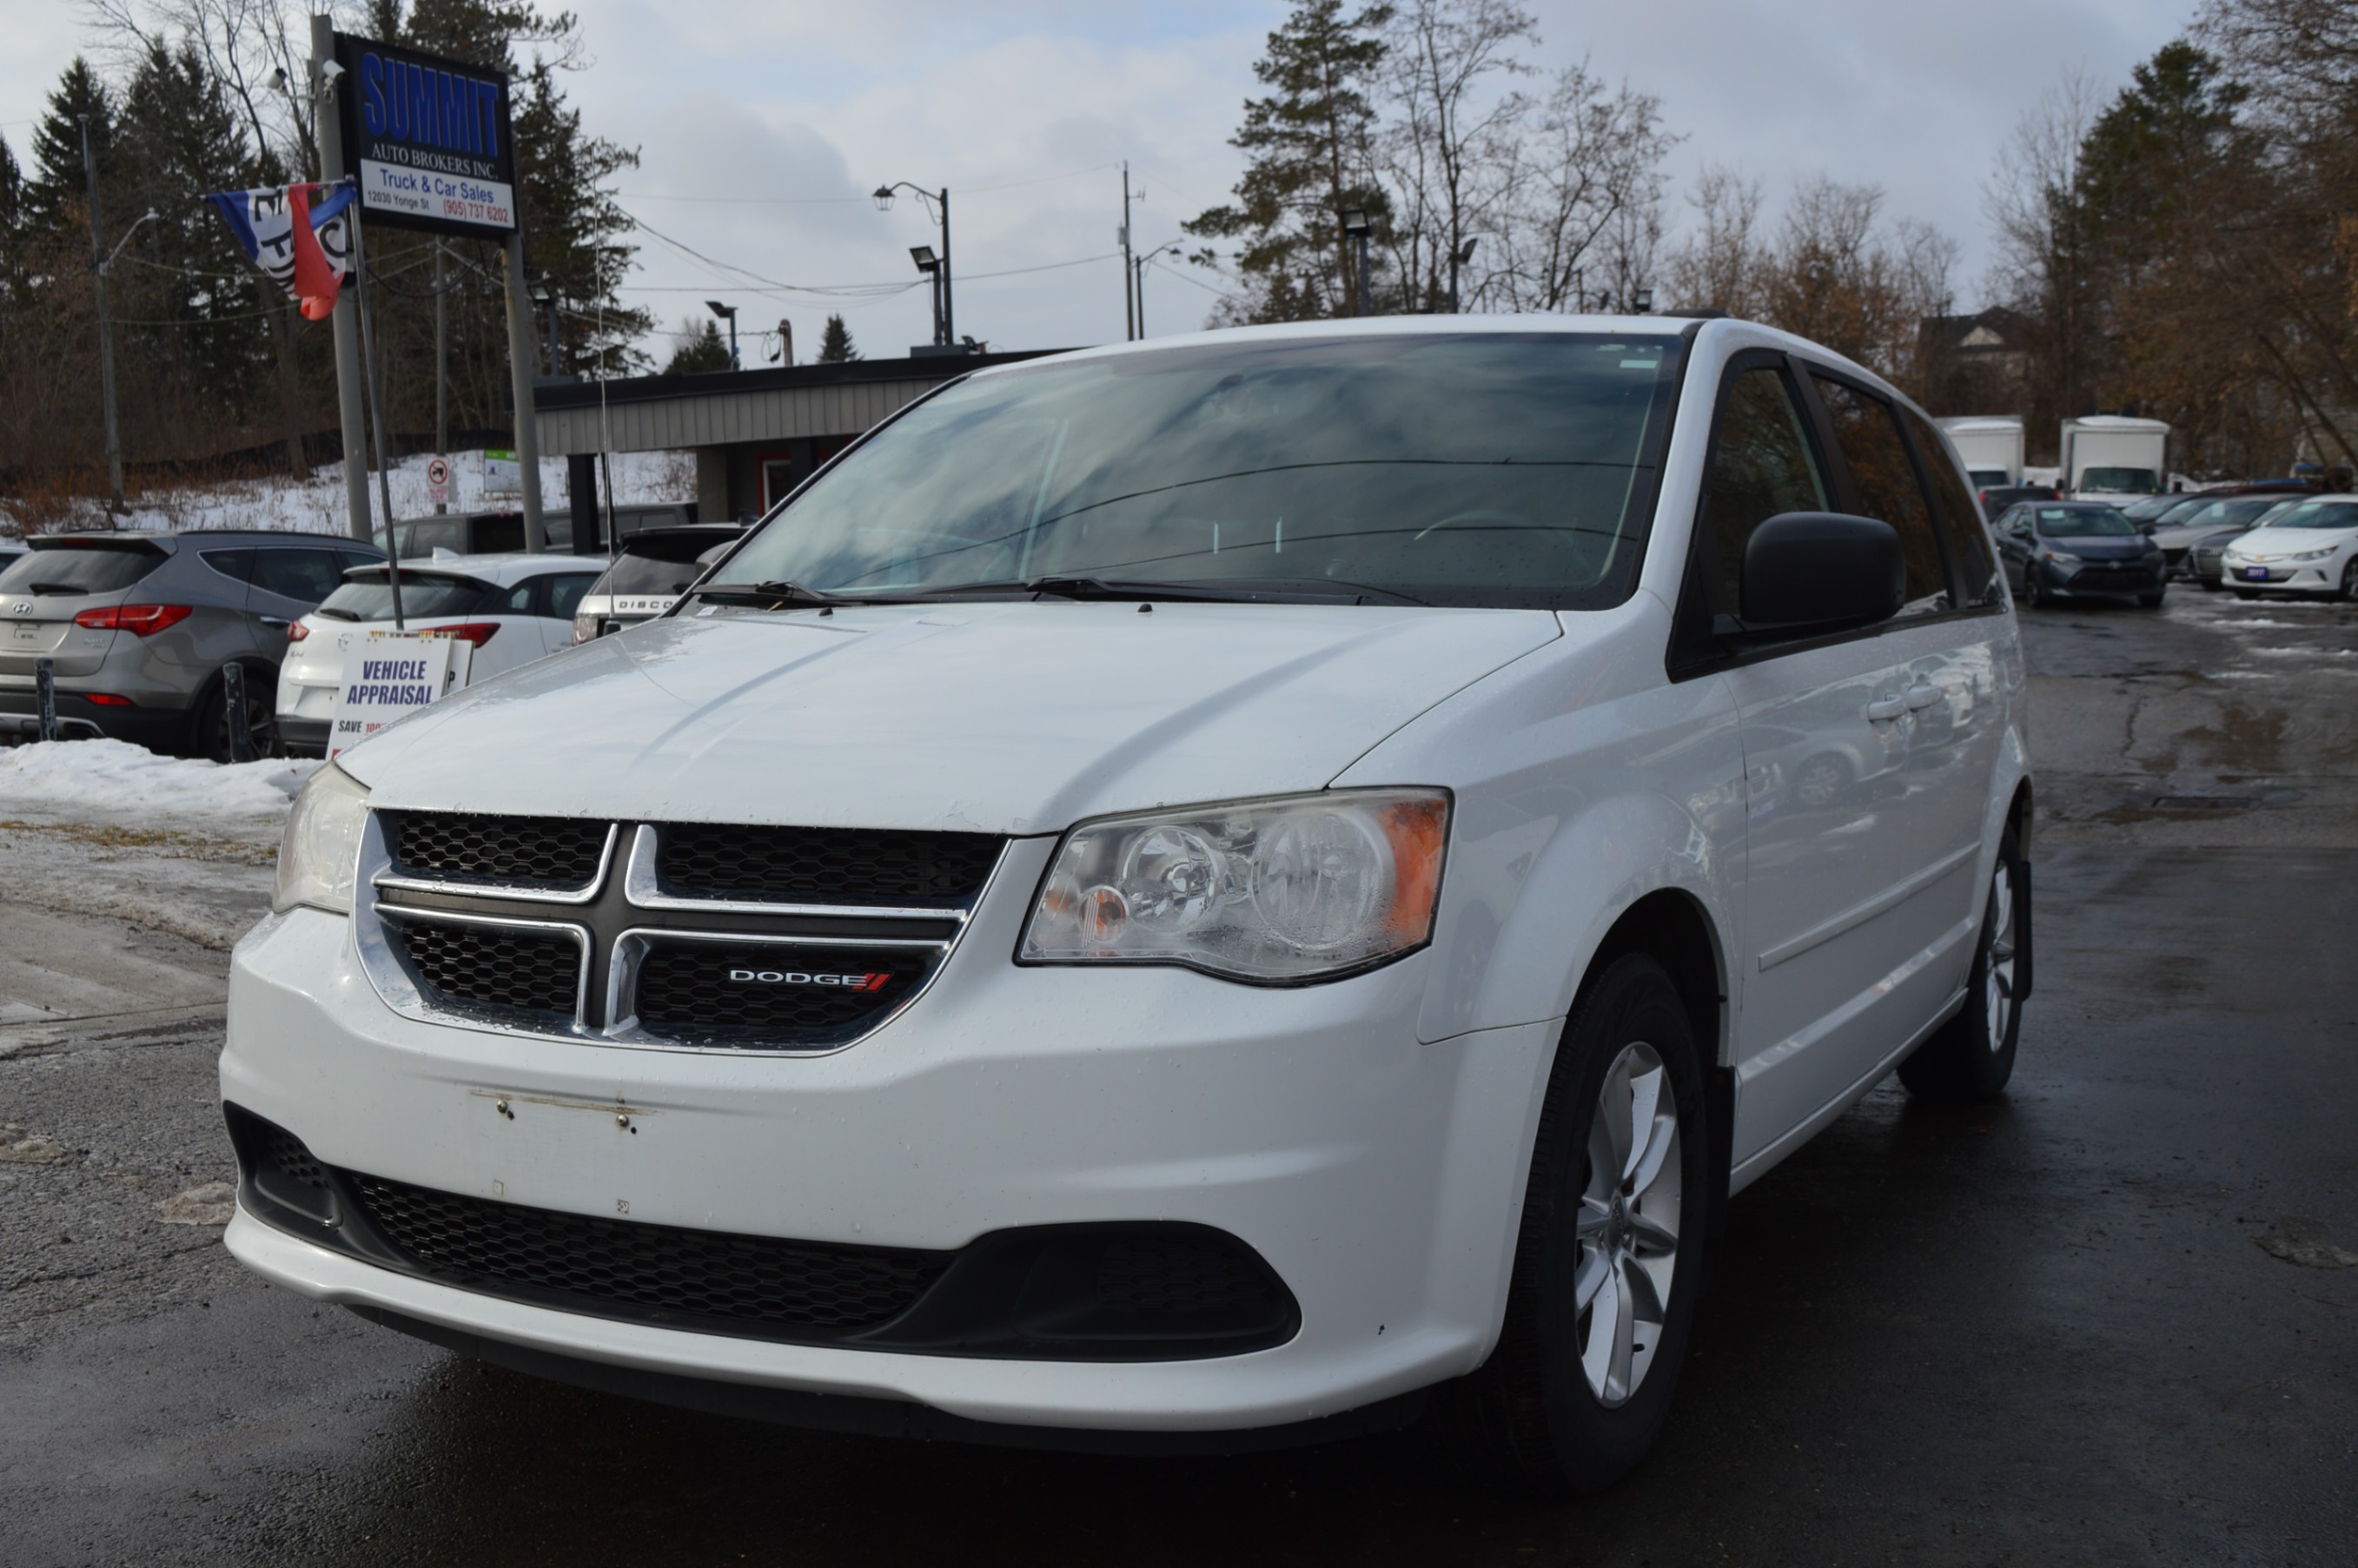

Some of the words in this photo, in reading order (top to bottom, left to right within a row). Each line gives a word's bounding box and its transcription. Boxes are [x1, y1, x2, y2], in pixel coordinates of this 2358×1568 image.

[361, 51, 500, 158] SUMMIT
[371, 142, 409, 164] AUTO
[411, 149, 471, 175] BROKERS
[473, 160, 499, 181] INC.
[380, 168, 418, 191] Truck
[421, 175, 432, 194] &
[434, 177, 457, 197] Car
[460, 181, 494, 204] Sales
[368, 189, 392, 204] 12030
[393, 194, 419, 210] Yonge
[421, 197, 430, 210] St
[443, 198, 467, 222] (905)
[468, 202, 484, 220] 737
[487, 205, 508, 223] 6202
[362, 660, 427, 680] VEHICLE
[346, 685, 433, 705] APPRAISAL
[338, 719, 362, 733] SAVE
[730, 969, 868, 987] DODGE
